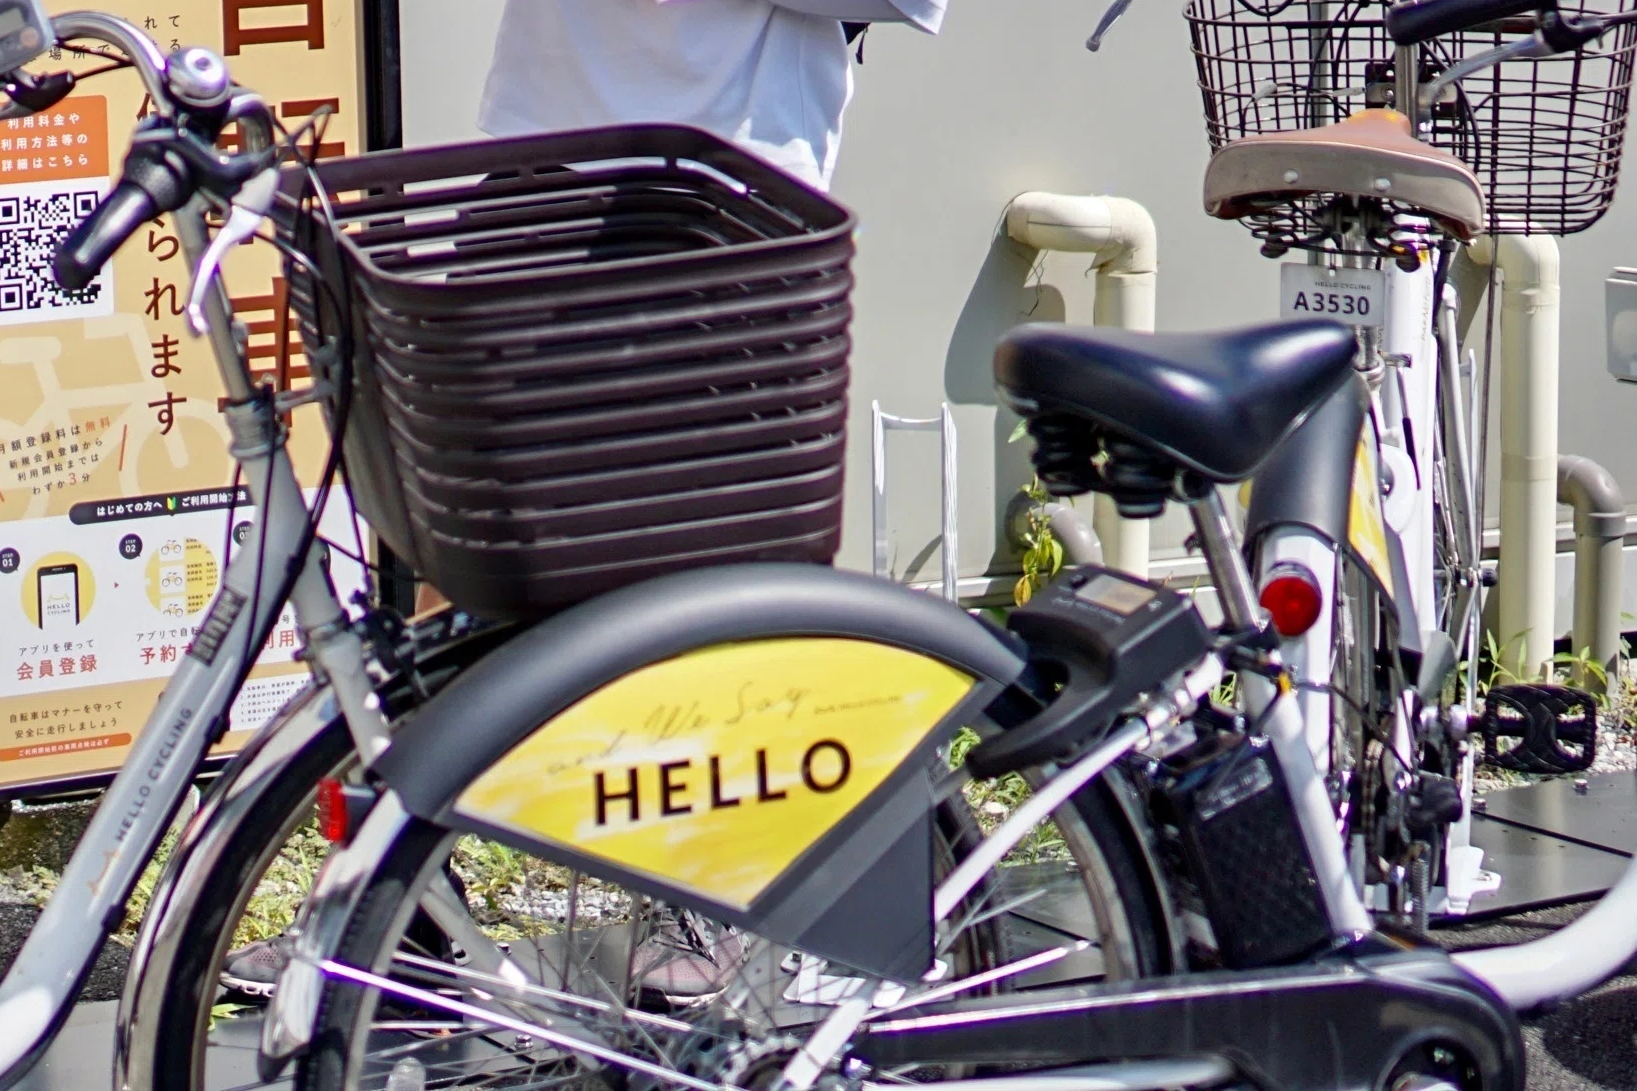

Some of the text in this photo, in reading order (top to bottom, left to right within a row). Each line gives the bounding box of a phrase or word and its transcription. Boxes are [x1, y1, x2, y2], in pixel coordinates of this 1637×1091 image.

[7, 112, 80, 129] 利用料金や
[0, 134, 88, 151] 利用方法等の
[1, 154, 89, 172] 詳細はこちら
[1315, 281, 1372, 291] HELLO CYCLING
[1293, 291, 1370, 316] A3530
[9, 437, 104, 470] 新規会員登録から
[17, 453, 100, 482] 利用開始までは
[32, 472, 91, 496] わずか3分
[97, 501, 163, 517] はじめての方へ
[125, 545, 136, 553] 02
[2, 559, 14, 568] 01
[47, 602, 71, 610] HELLO
[19, 639, 94, 657] アプリを使って
[16, 654, 97, 681] 会員登録
[9, 701, 123, 723] 自転車はマナーを守って
[14, 717, 118, 740] 安全に走行しましょう
[643, 701, 711, 746] We
[147, 707, 193, 781] CYCLING
[593, 737, 852, 827] HELLO
[114, 784, 151, 843] HELLO
